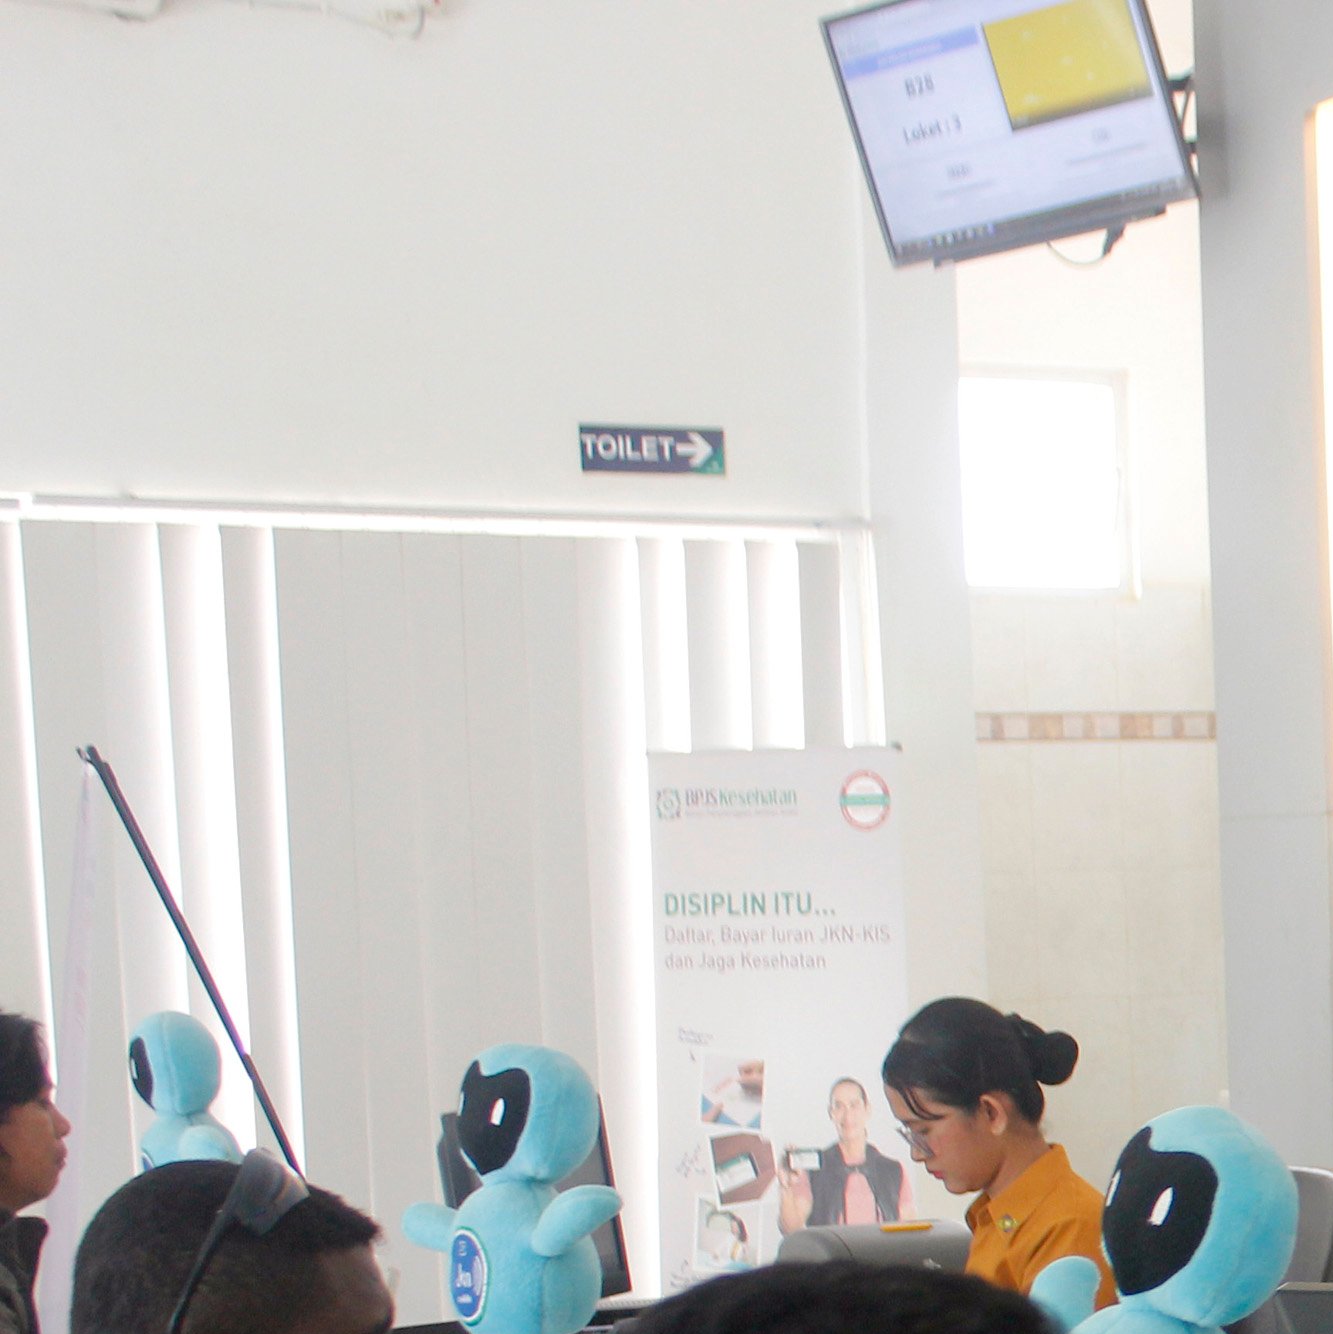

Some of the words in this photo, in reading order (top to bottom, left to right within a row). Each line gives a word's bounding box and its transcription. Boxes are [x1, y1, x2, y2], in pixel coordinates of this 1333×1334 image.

[580, 433, 674, 463] TOILET
[664, 892, 766, 916] DISIPLIN
[774, 891, 836, 916] ITU...
[664, 925, 715, 946] Daftar,
[720, 925, 766, 947] Bayar
[818, 924, 891, 944] JKN-KIS
[664, 953, 693, 969] dan
[698, 953, 735, 973] Jaga
[741, 953, 827, 969] Kesehatan
